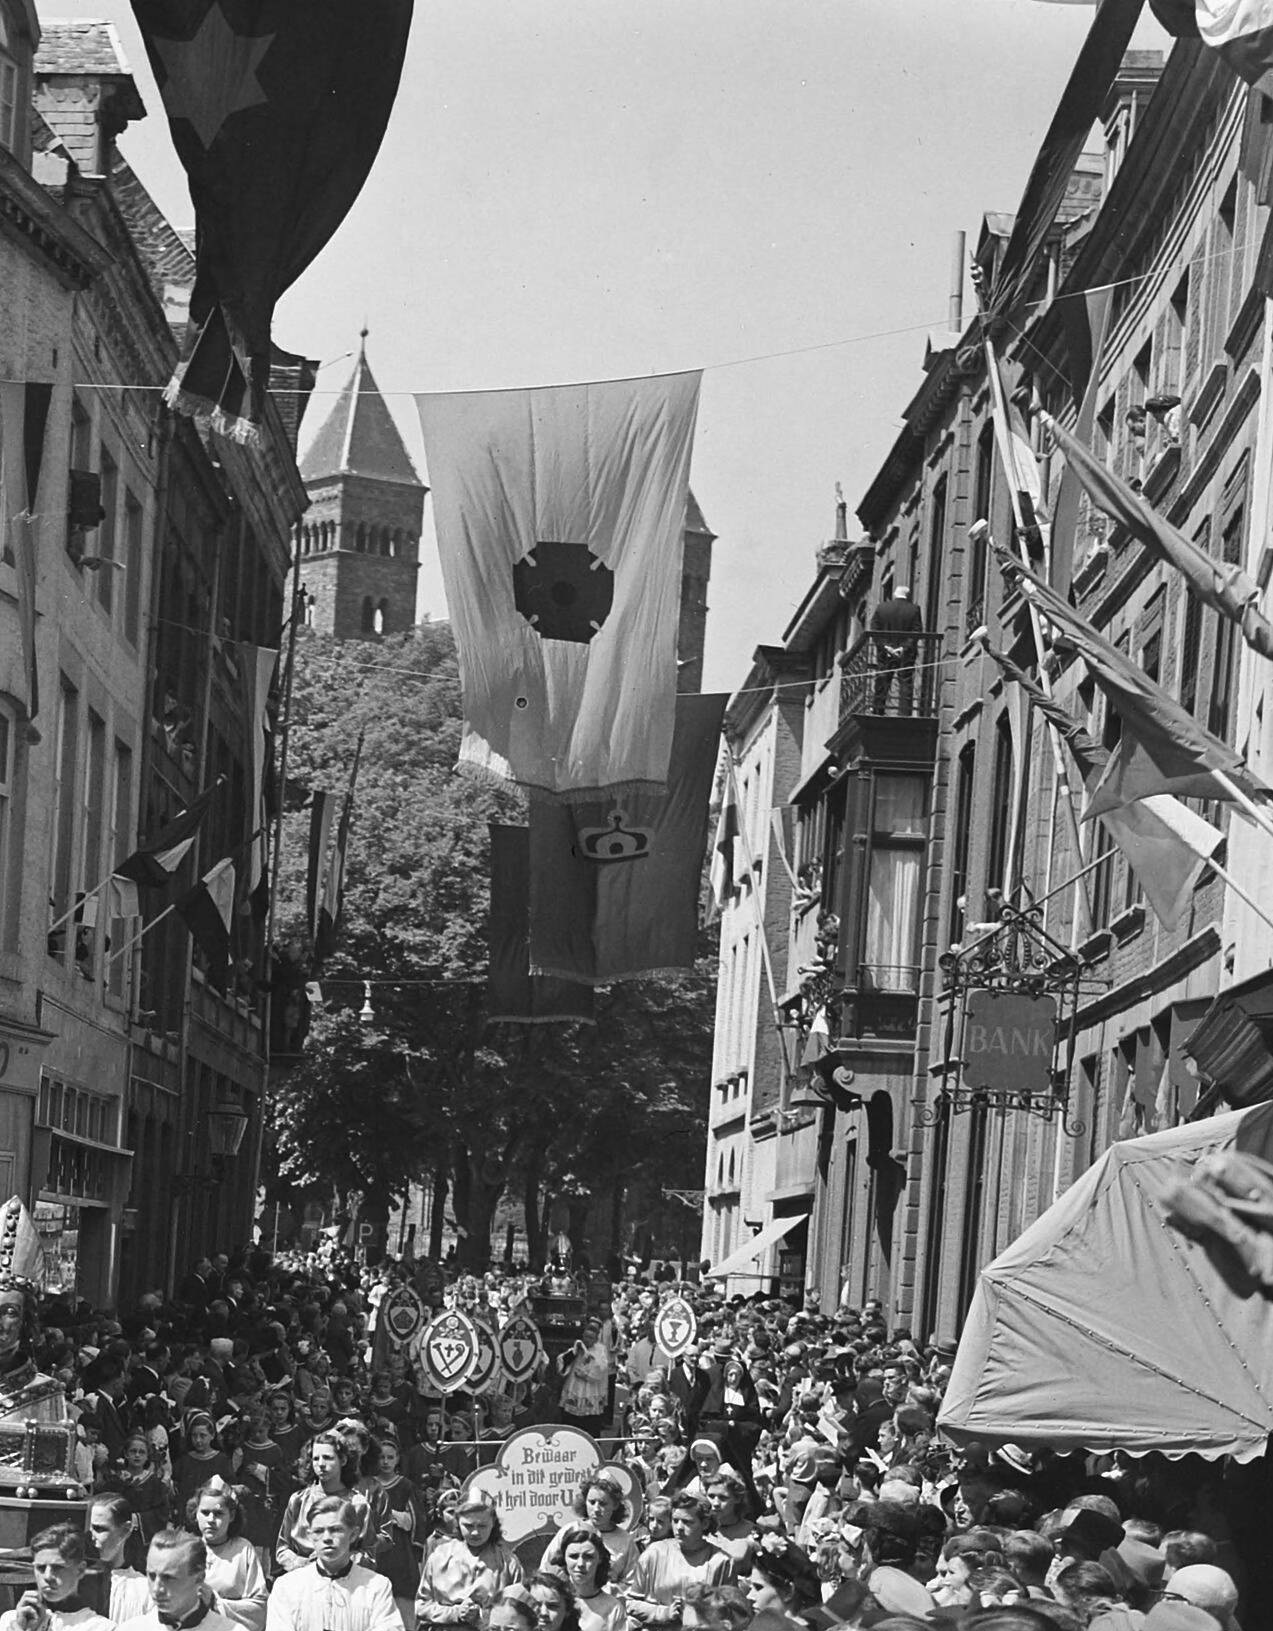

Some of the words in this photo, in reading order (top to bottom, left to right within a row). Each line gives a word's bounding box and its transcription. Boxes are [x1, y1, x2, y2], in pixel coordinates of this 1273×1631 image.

[970, 1023, 1051, 1057] BANK
[359, 1223, 373, 1243] P
[522, 1447, 577, 1465] Bewaar
[511, 1470, 524, 1485] in
[528, 1468, 545, 1485] dit
[505, 1490, 526, 1511] heil
[530, 1490, 560, 1506] door
